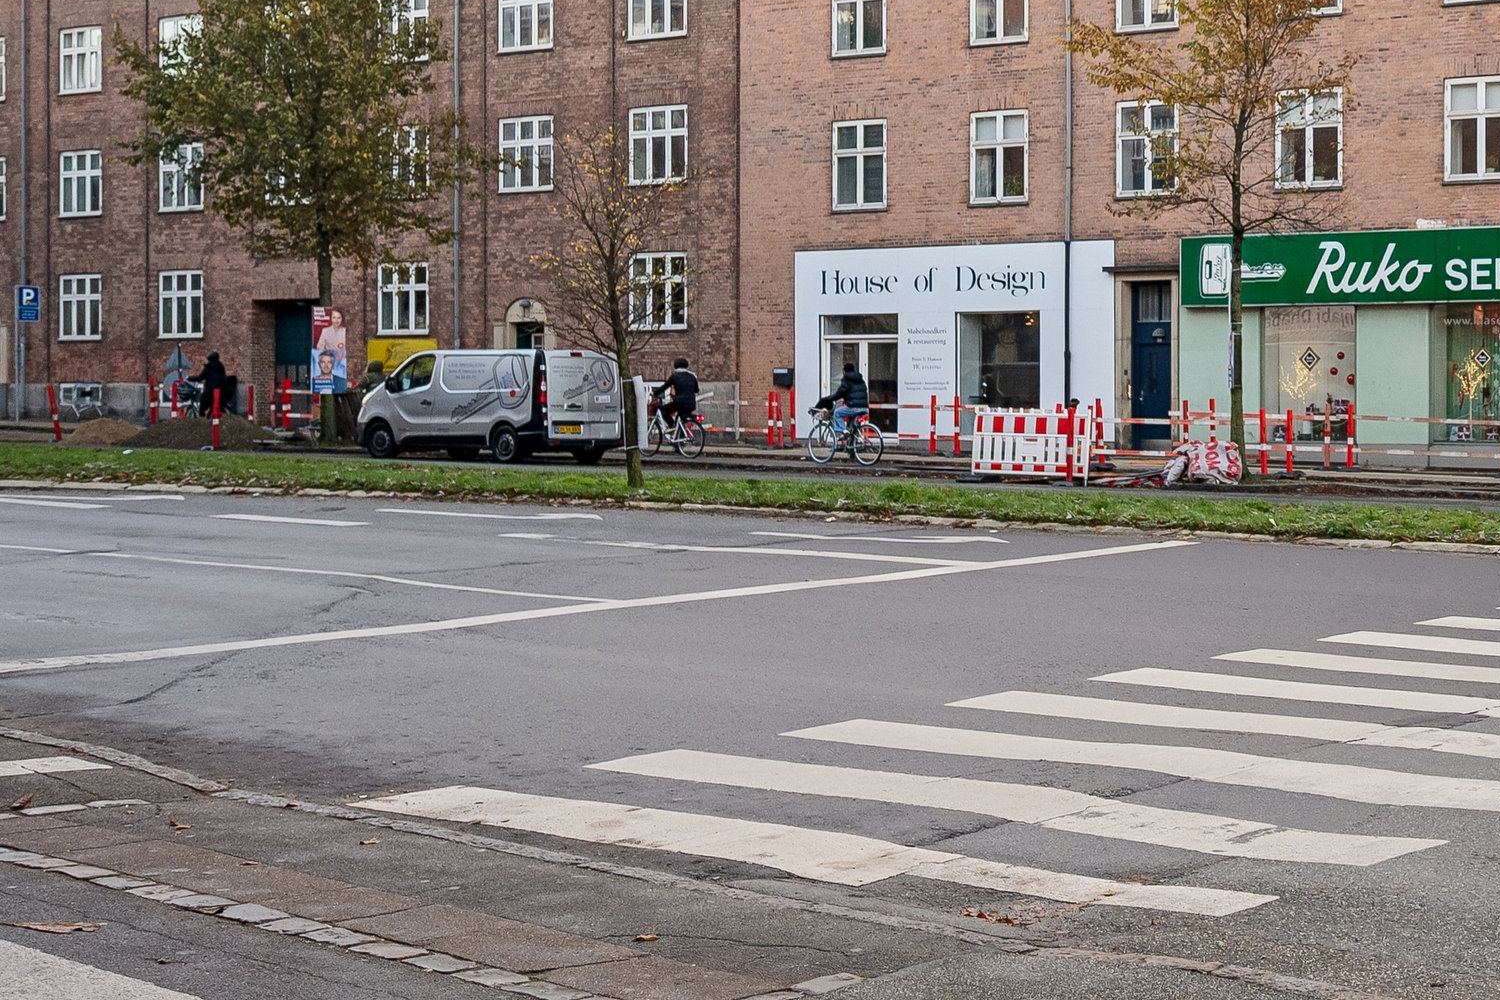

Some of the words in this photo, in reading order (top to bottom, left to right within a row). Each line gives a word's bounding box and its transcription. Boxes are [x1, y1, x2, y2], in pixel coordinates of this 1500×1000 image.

[820, 269, 898, 295] House
[914, 267, 938, 293] of
[955, 265, 1046, 297] Design
[1305, 240, 1432, 294] Ruko
[22, 289, 35, 306] P
